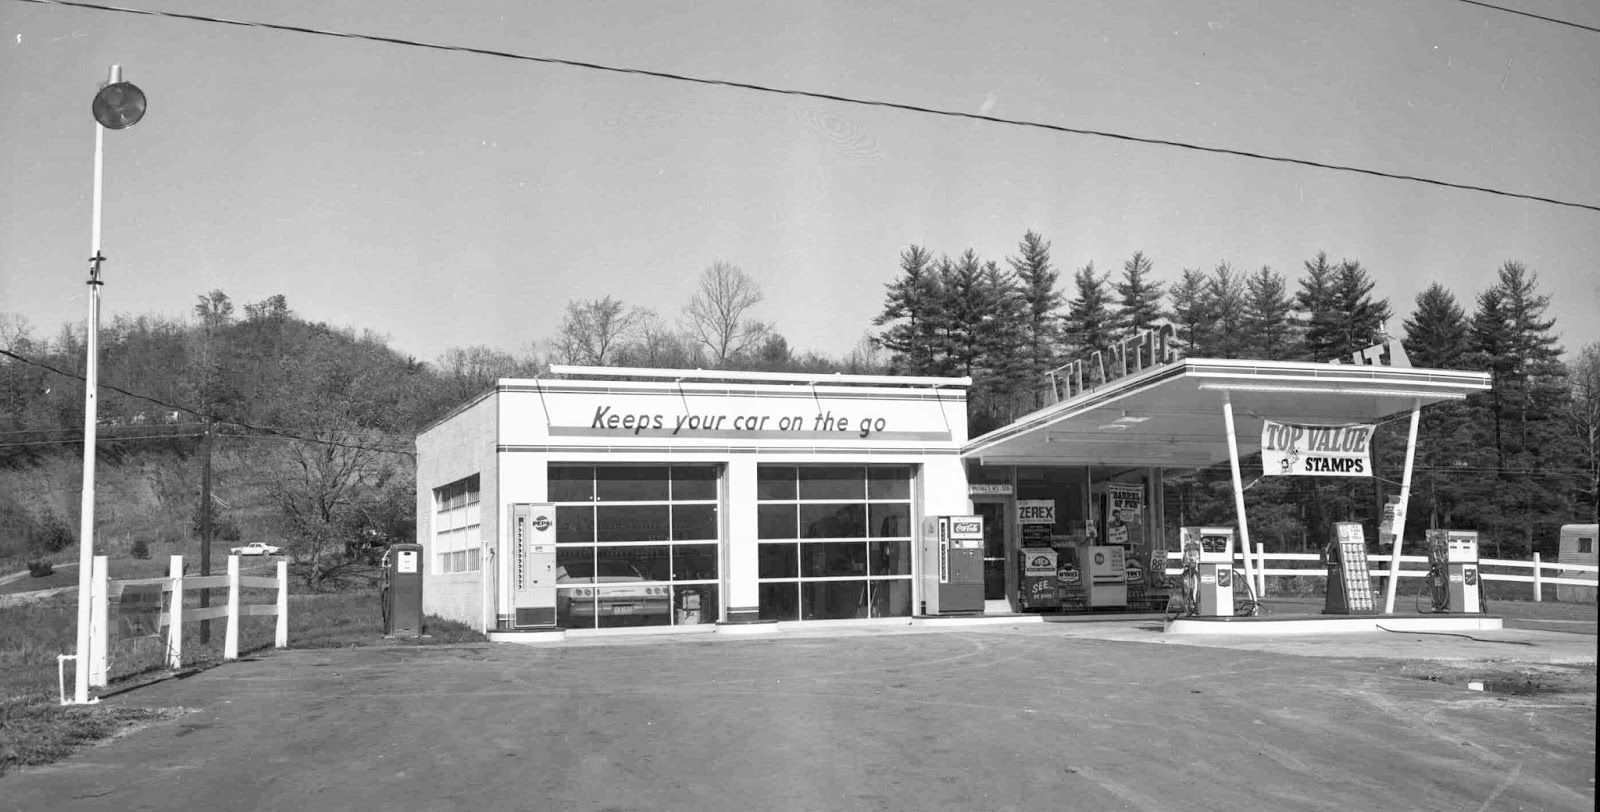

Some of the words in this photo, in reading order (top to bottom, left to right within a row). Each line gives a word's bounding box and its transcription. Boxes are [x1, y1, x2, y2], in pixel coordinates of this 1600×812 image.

[591, 406, 664, 435] Keeps
[672, 414, 727, 436] your
[733, 415, 770, 431] car
[778, 415, 804, 432] on
[813, 410, 849, 432] the
[859, 417, 887, 438] go
[1266, 424, 1304, 451] TOP
[1307, 427, 1370, 453] VALUE
[1305, 457, 1364, 473] STAMPS
[1018, 506, 1053, 519] ZEREX
[955, 523, 979, 533] Coca-Cola
